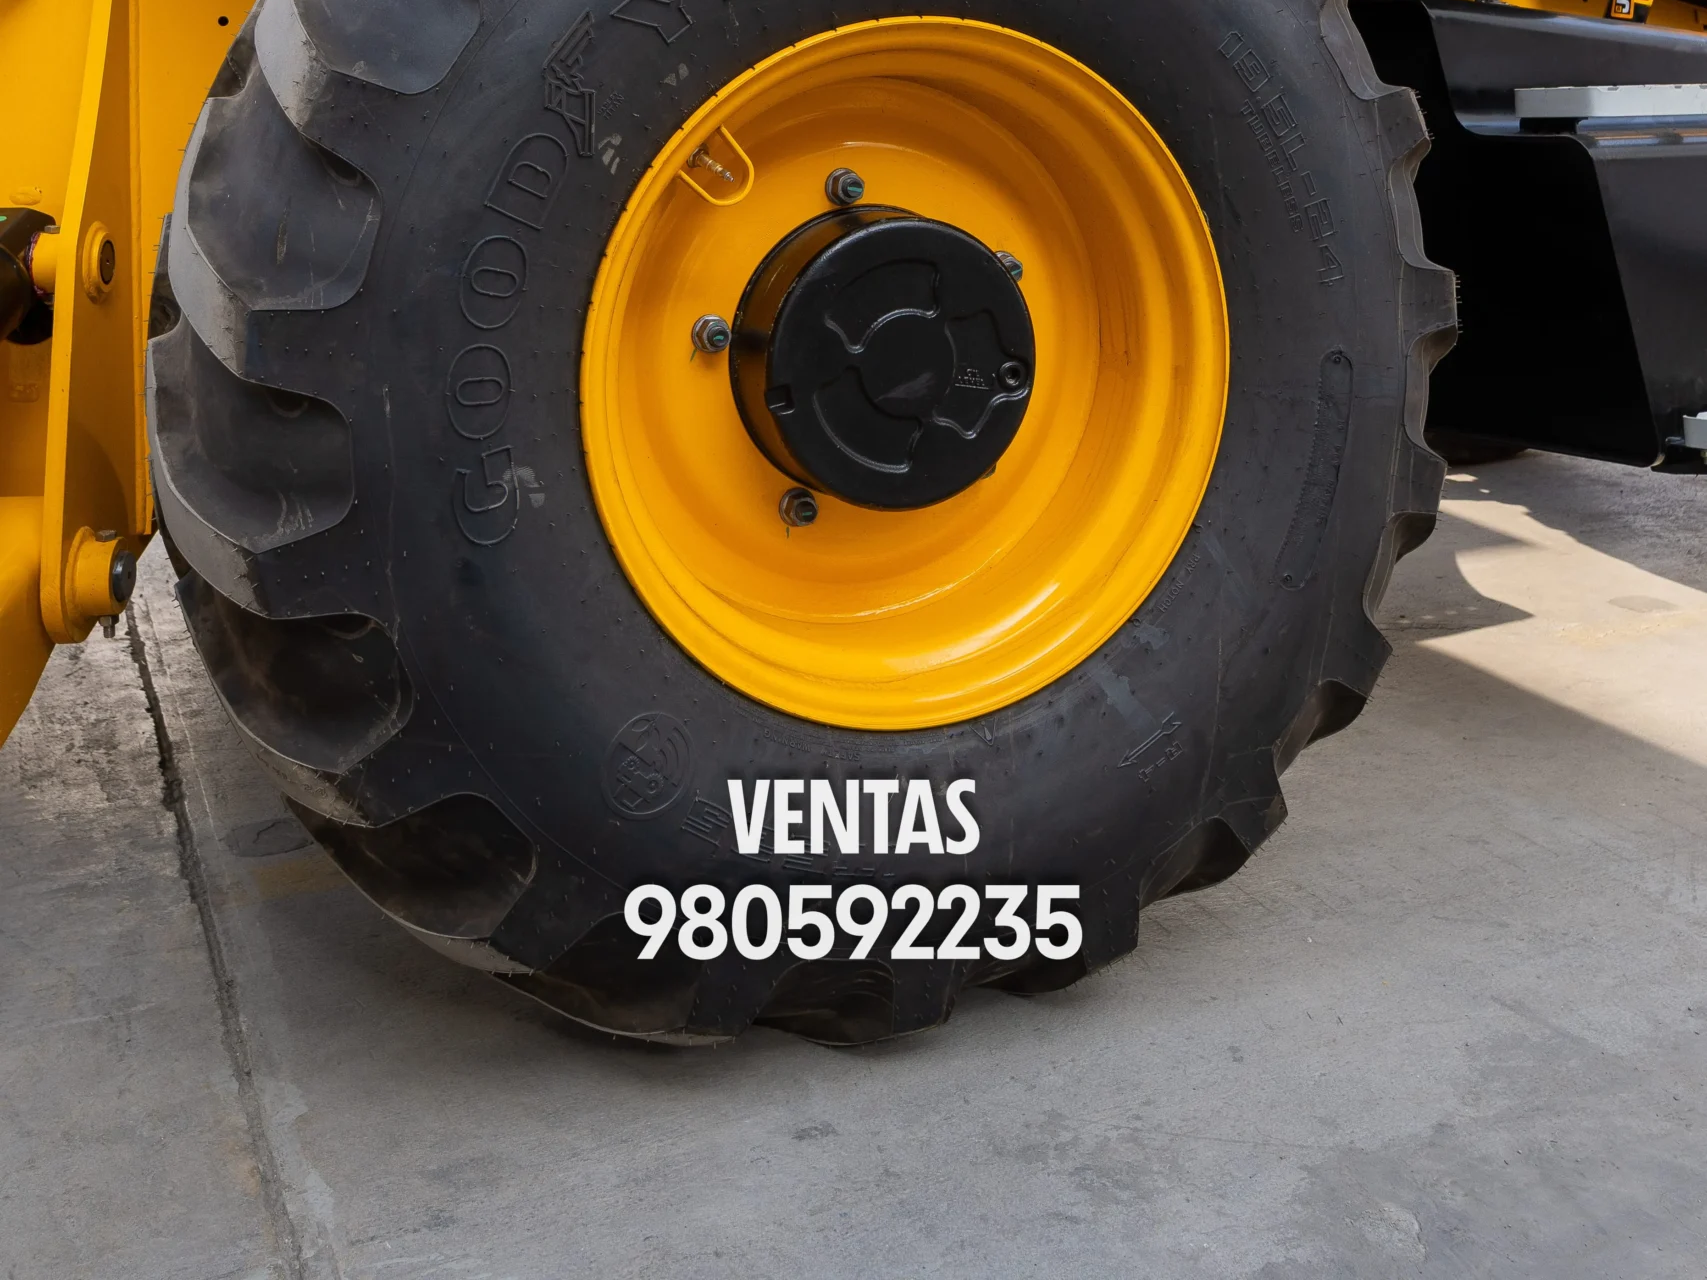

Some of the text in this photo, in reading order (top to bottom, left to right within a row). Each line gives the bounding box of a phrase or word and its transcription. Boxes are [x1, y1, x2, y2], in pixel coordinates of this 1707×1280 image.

[1240, 98, 1304, 233] TUBELESS
[1156, 552, 1201, 613] PRY NOTCH
